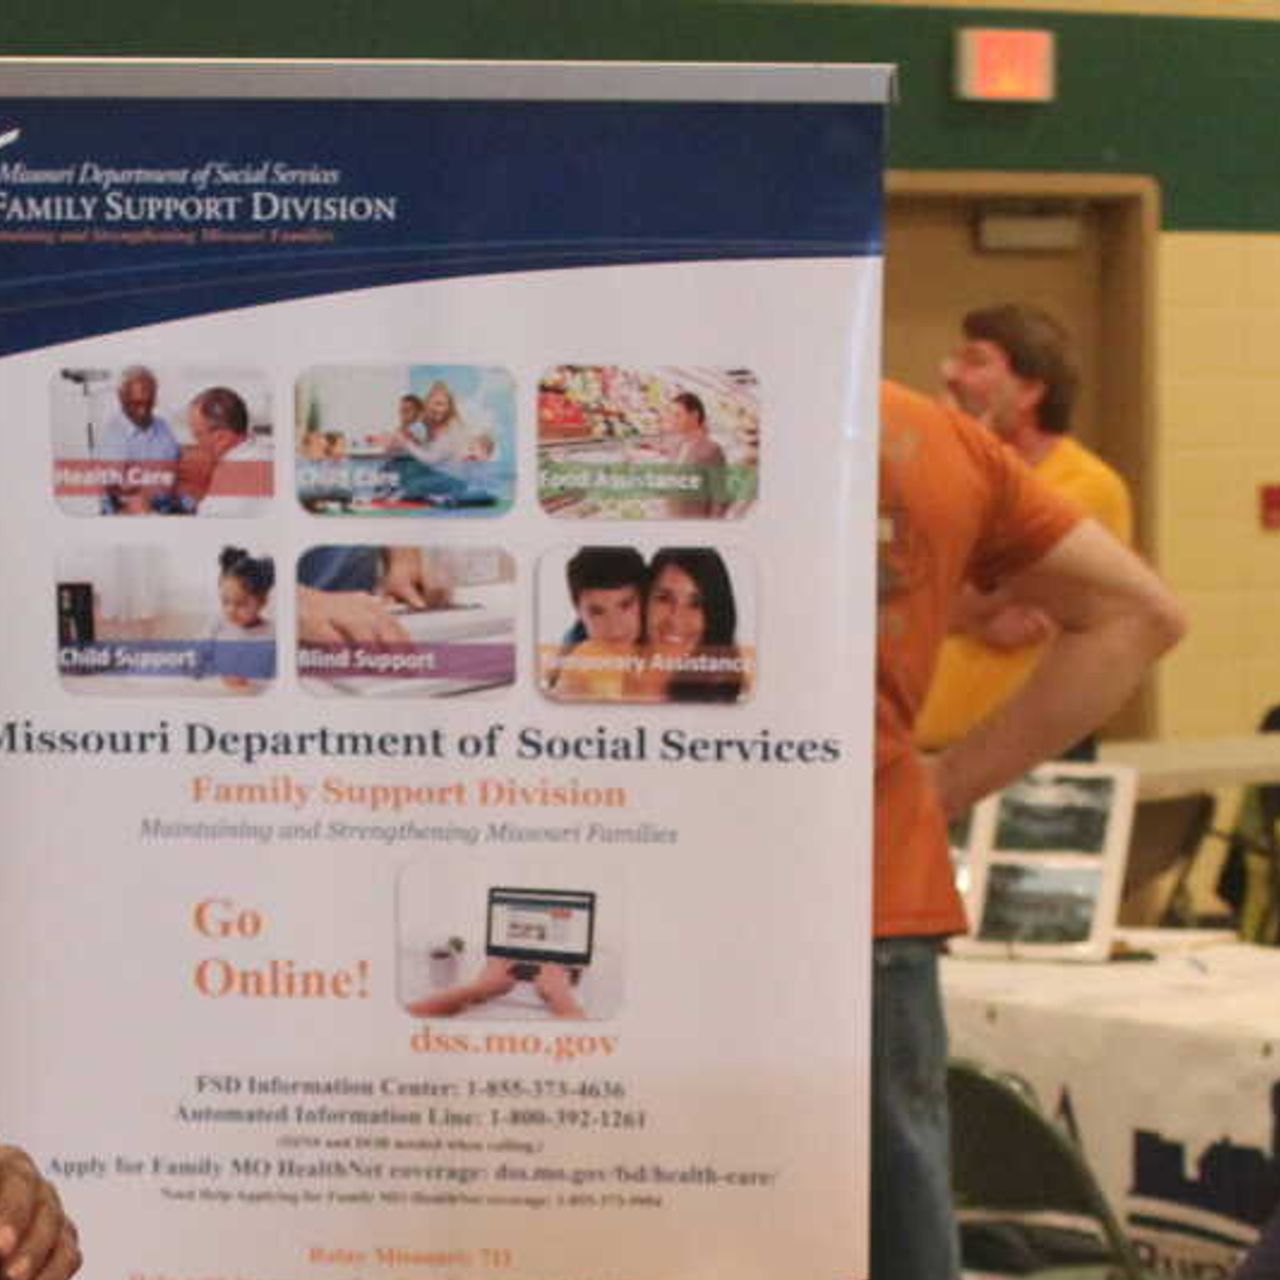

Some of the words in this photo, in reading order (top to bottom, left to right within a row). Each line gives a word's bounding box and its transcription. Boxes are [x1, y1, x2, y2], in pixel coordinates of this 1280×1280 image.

[79, 163, 186, 190] Department
[190, 163, 212, 190] of
[105, 191, 241, 221] SUPPORT
[251, 191, 396, 221] DIVISION
[56, 466, 122, 486] Health
[127, 467, 176, 486] Care
[60, 646, 112, 668] Child
[116, 647, 197, 673] Support
[297, 648, 349, 668] Blind
[353, 648, 436, 674] Support
[185, 722, 445, 763] Department
[457, 725, 504, 759] of
[518, 727, 647, 761] Social
[659, 729, 842, 763] Services
[190, 776, 309, 809] Family
[321, 777, 468, 812] Support
[478, 779, 628, 809] Division
[139, 819, 272, 844] Maintaining
[278, 821, 319, 840] and
[325, 821, 479, 847] Strengthening
[485, 823, 580, 844] Missouri
[586, 824, 680, 845] Families
[191, 896, 263, 939] Go
[193, 957, 372, 999] Online!
[410, 1025, 619, 1060] dss.mo.gov
[195, 1075, 241, 1095] FSD
[247, 1075, 374, 1097] Information
[379, 1077, 459, 1098] Center:
[177, 1105, 289, 1124] Automated
[295, 1106, 422, 1126] Information
[428, 1108, 486, 1127] Line:
[47, 1156, 107, 1179] Apply
[114, 1156, 145, 1176] for
[150, 1157, 223, 1180] Family
[230, 1158, 273, 1177] MO
[277, 1158, 384, 1179] HealthNet
[389, 1163, 487, 1185] coverage:
